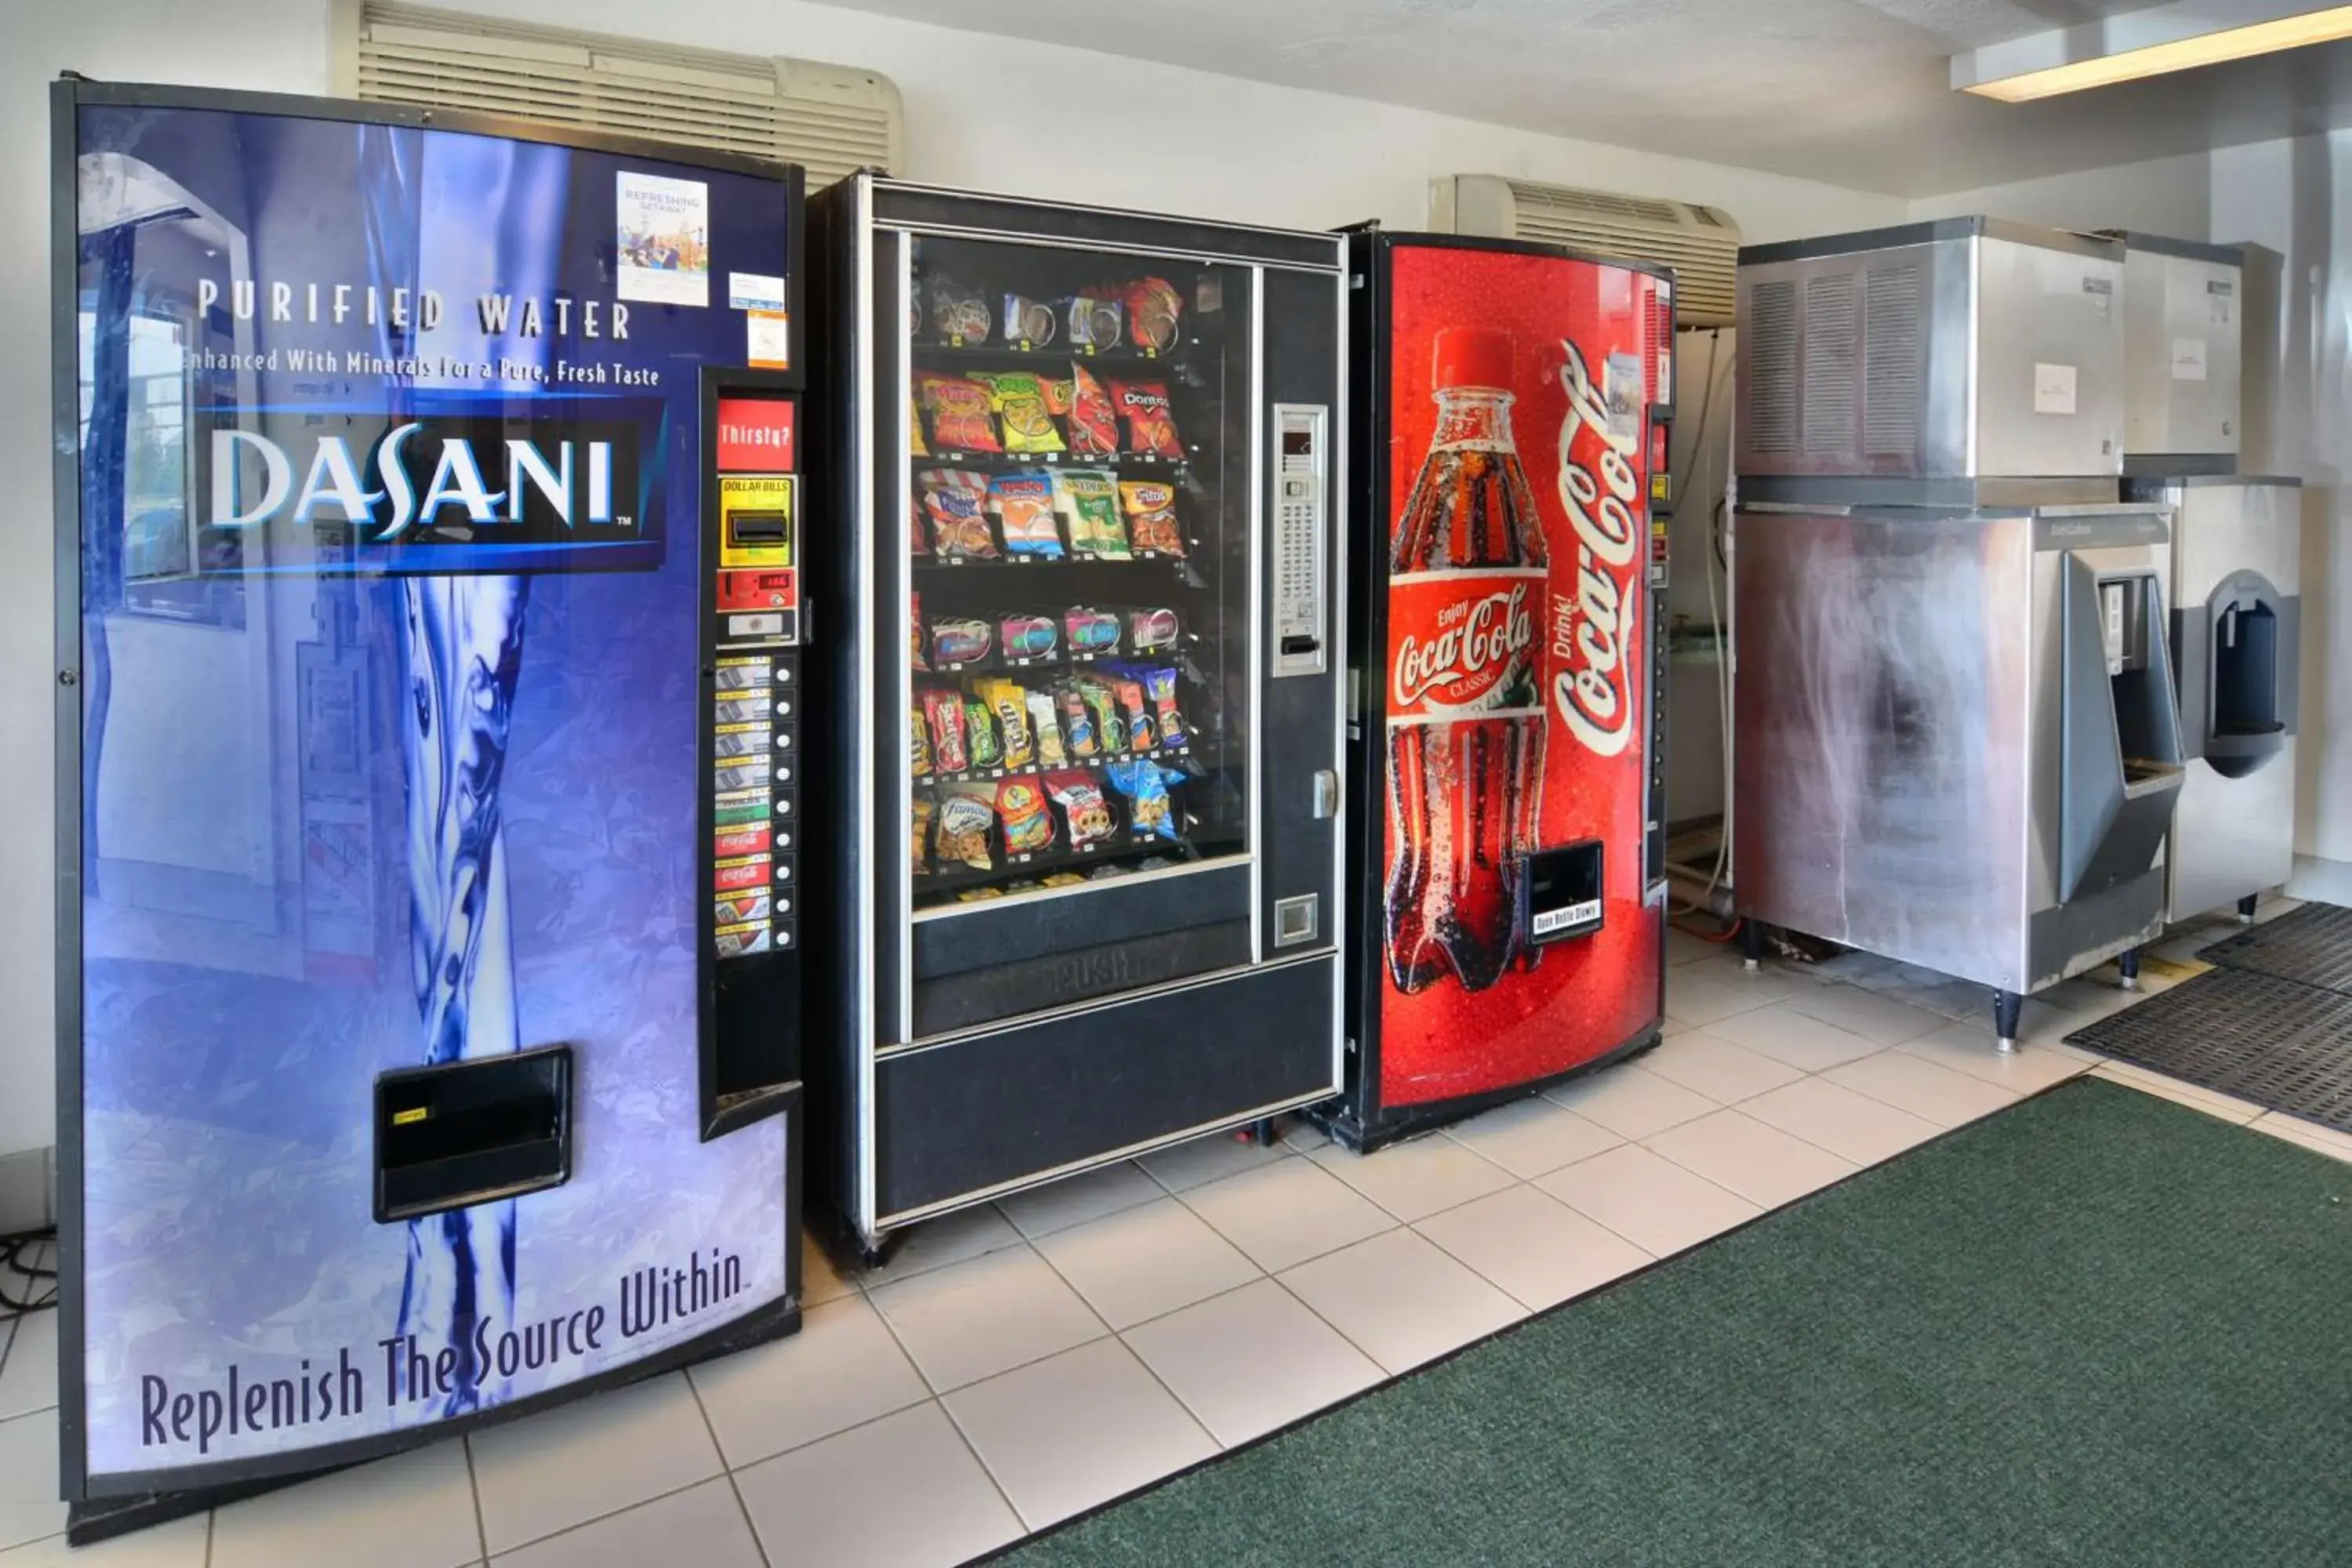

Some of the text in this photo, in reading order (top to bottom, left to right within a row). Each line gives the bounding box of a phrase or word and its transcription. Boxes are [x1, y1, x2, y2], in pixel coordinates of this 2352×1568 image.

[626, 189, 700, 208] REFRESHING
[198, 278, 630, 339] PURIFIED WATER
[287, 350, 337, 372] With
[347, 352, 434, 376] Minerals
[480, 364, 492, 378] a
[499, 358, 550, 383] Pure,
[557, 361, 606, 383] Fresh
[613, 364, 659, 385] Taste
[720, 425, 790, 449] Thirsty?
[211, 423, 612, 539] DASANI
[724, 481, 788, 492] DOLLAR BILLS
[1438, 600, 1468, 627] Enjoy
[1553, 593, 1572, 659] Drink!
[1394, 583, 1531, 706] Coca-Cola
[1450, 669, 1495, 697] CLASSIC
[1537, 916, 1553, 930] Open
[142, 1347, 363, 1454] Replenish
[379, 1334, 458, 1406] The
[474, 1305, 604, 1386] Source
[620, 1247, 740, 1338] Within
